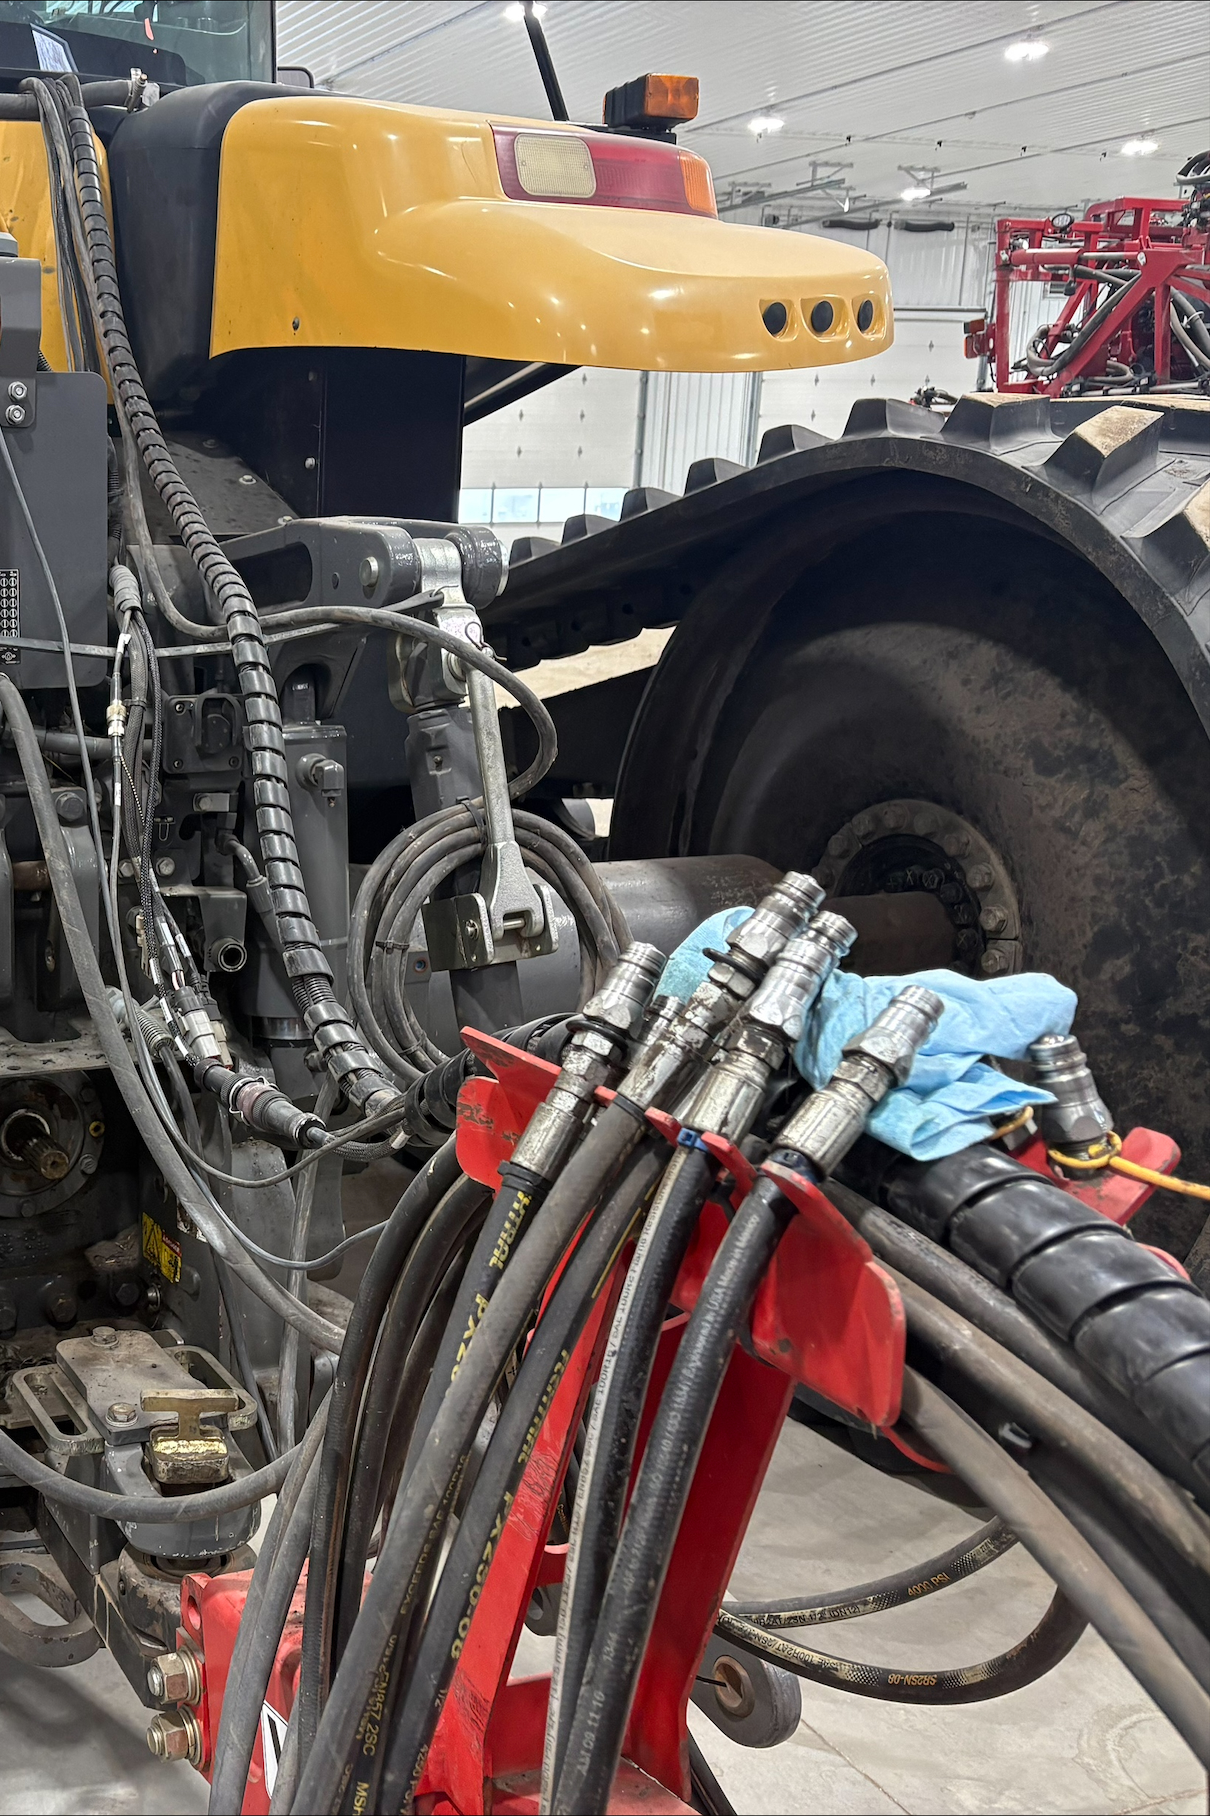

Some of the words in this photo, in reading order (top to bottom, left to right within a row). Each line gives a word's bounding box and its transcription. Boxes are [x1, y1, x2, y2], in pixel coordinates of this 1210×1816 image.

[705, 1284, 726, 1311] USA
[906, 1579, 933, 1598] 4000
[930, 1570, 951, 1588] PSI
[887, 1671, 936, 1686] SR2SN-08
[360, 1722, 381, 1756] 2SC
